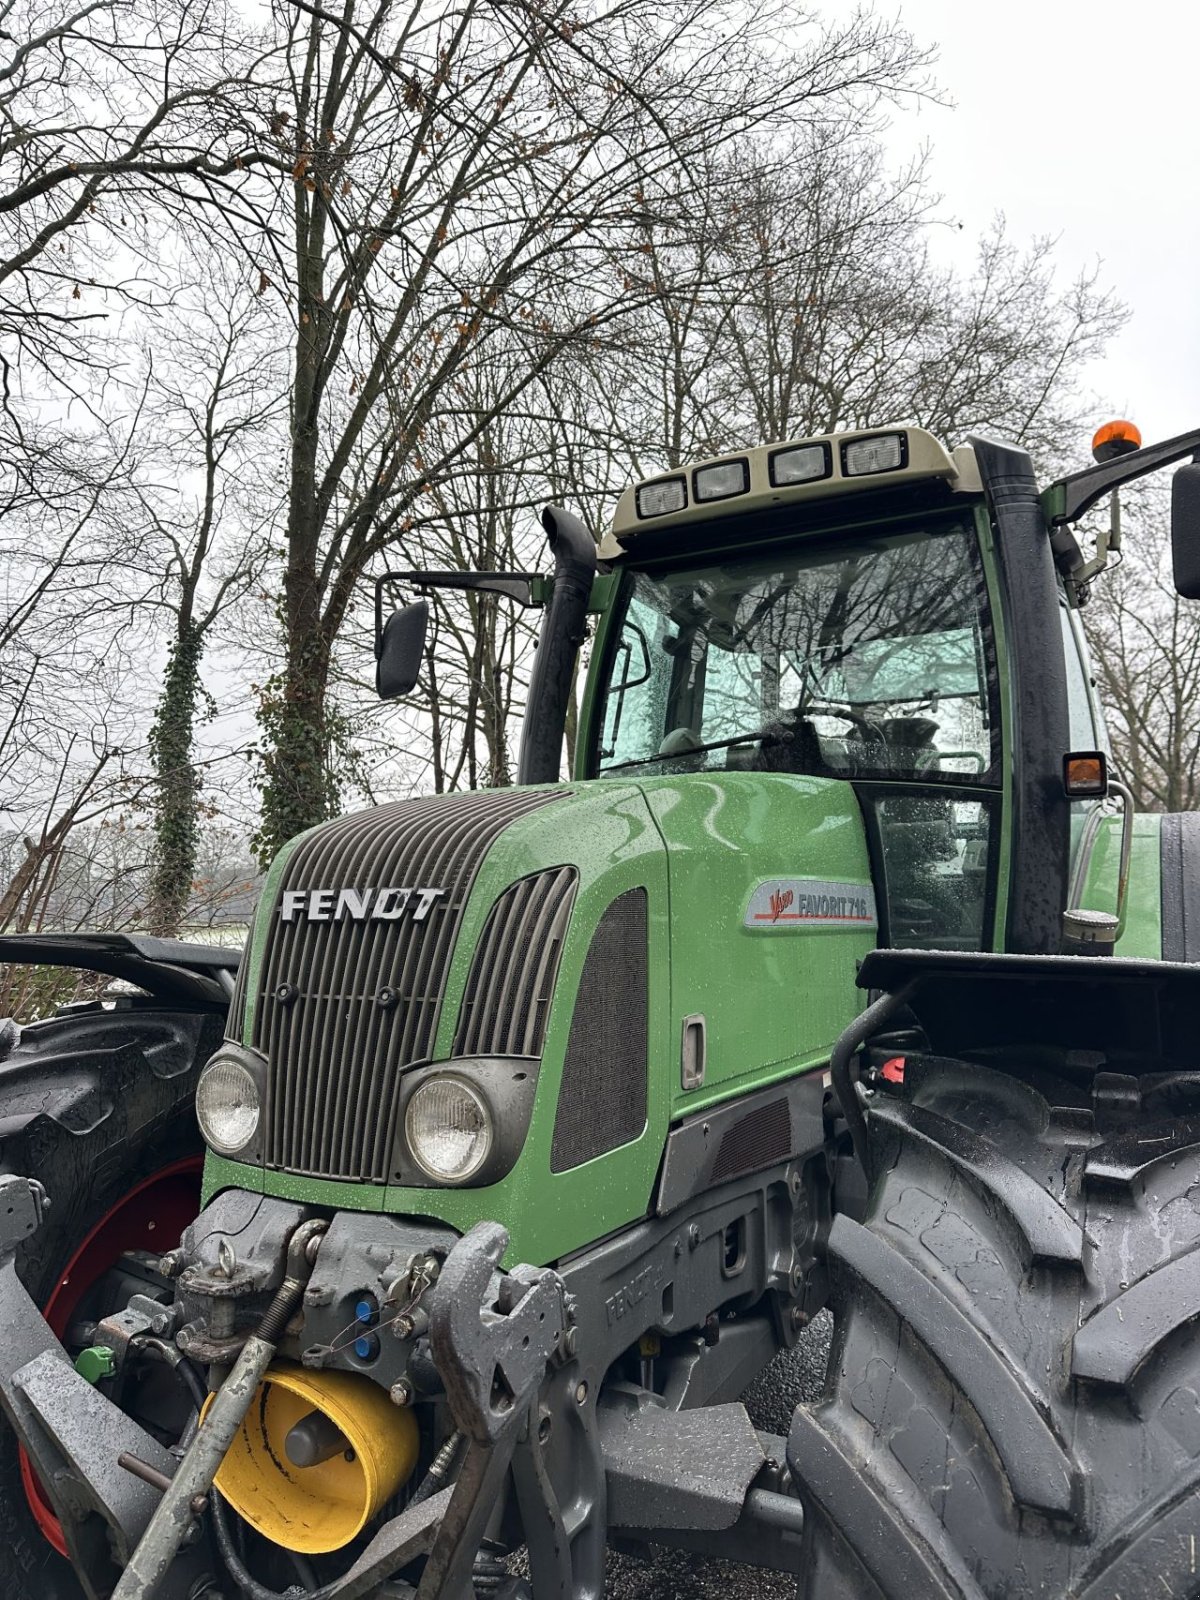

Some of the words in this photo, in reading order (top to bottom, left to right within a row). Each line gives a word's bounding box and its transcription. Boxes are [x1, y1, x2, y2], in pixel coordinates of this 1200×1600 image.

[281, 887, 445, 921] FENDT
[798, 893, 847, 918] FAVORIT
[849, 897, 867, 920] 716
